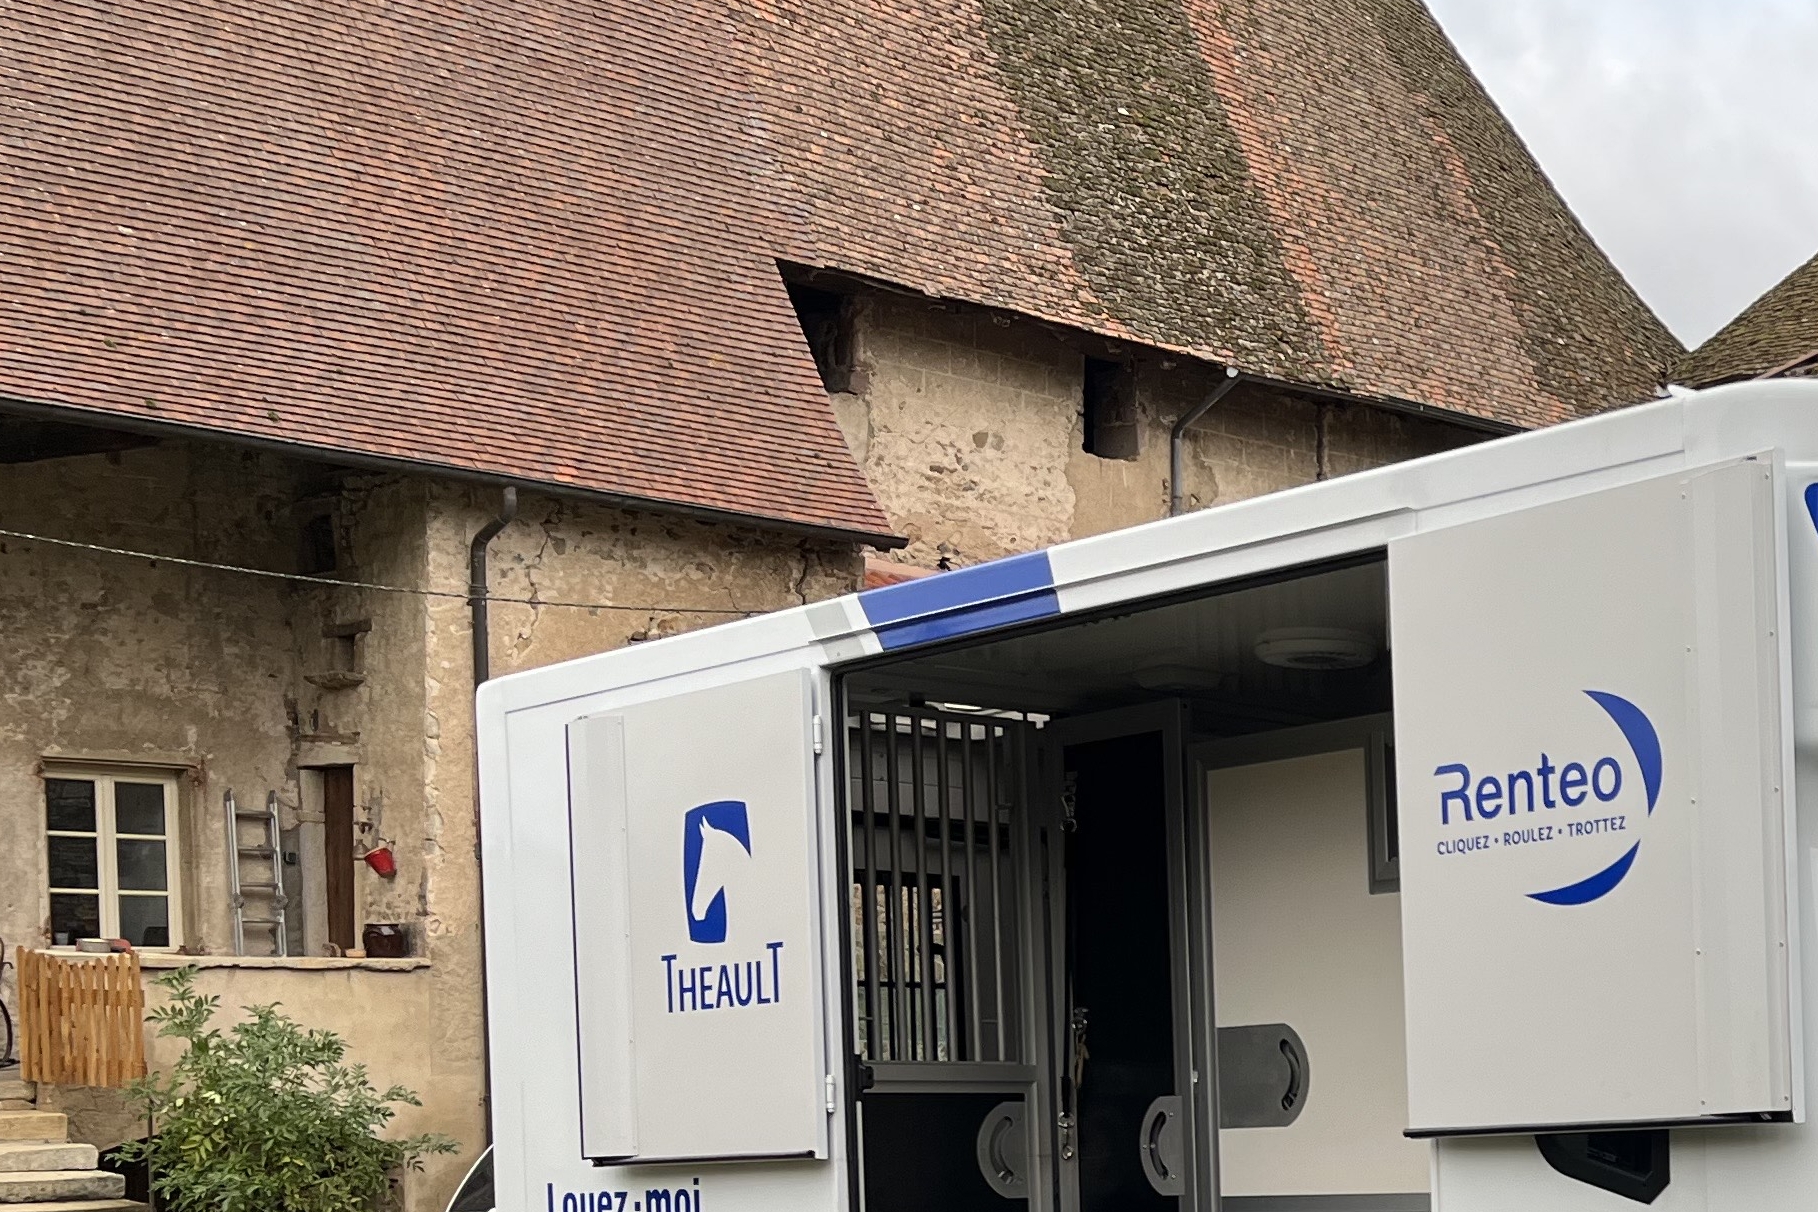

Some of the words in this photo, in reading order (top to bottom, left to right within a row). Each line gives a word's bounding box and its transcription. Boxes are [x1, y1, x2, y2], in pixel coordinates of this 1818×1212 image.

[1434, 753, 1623, 825] Renteo
[1436, 835, 1490, 855] CLIQUEZ
[1503, 826, 1554, 847] ROULEZ
[1567, 816, 1627, 838] TROTTEZ
[661, 942, 783, 1013] THEAULT
